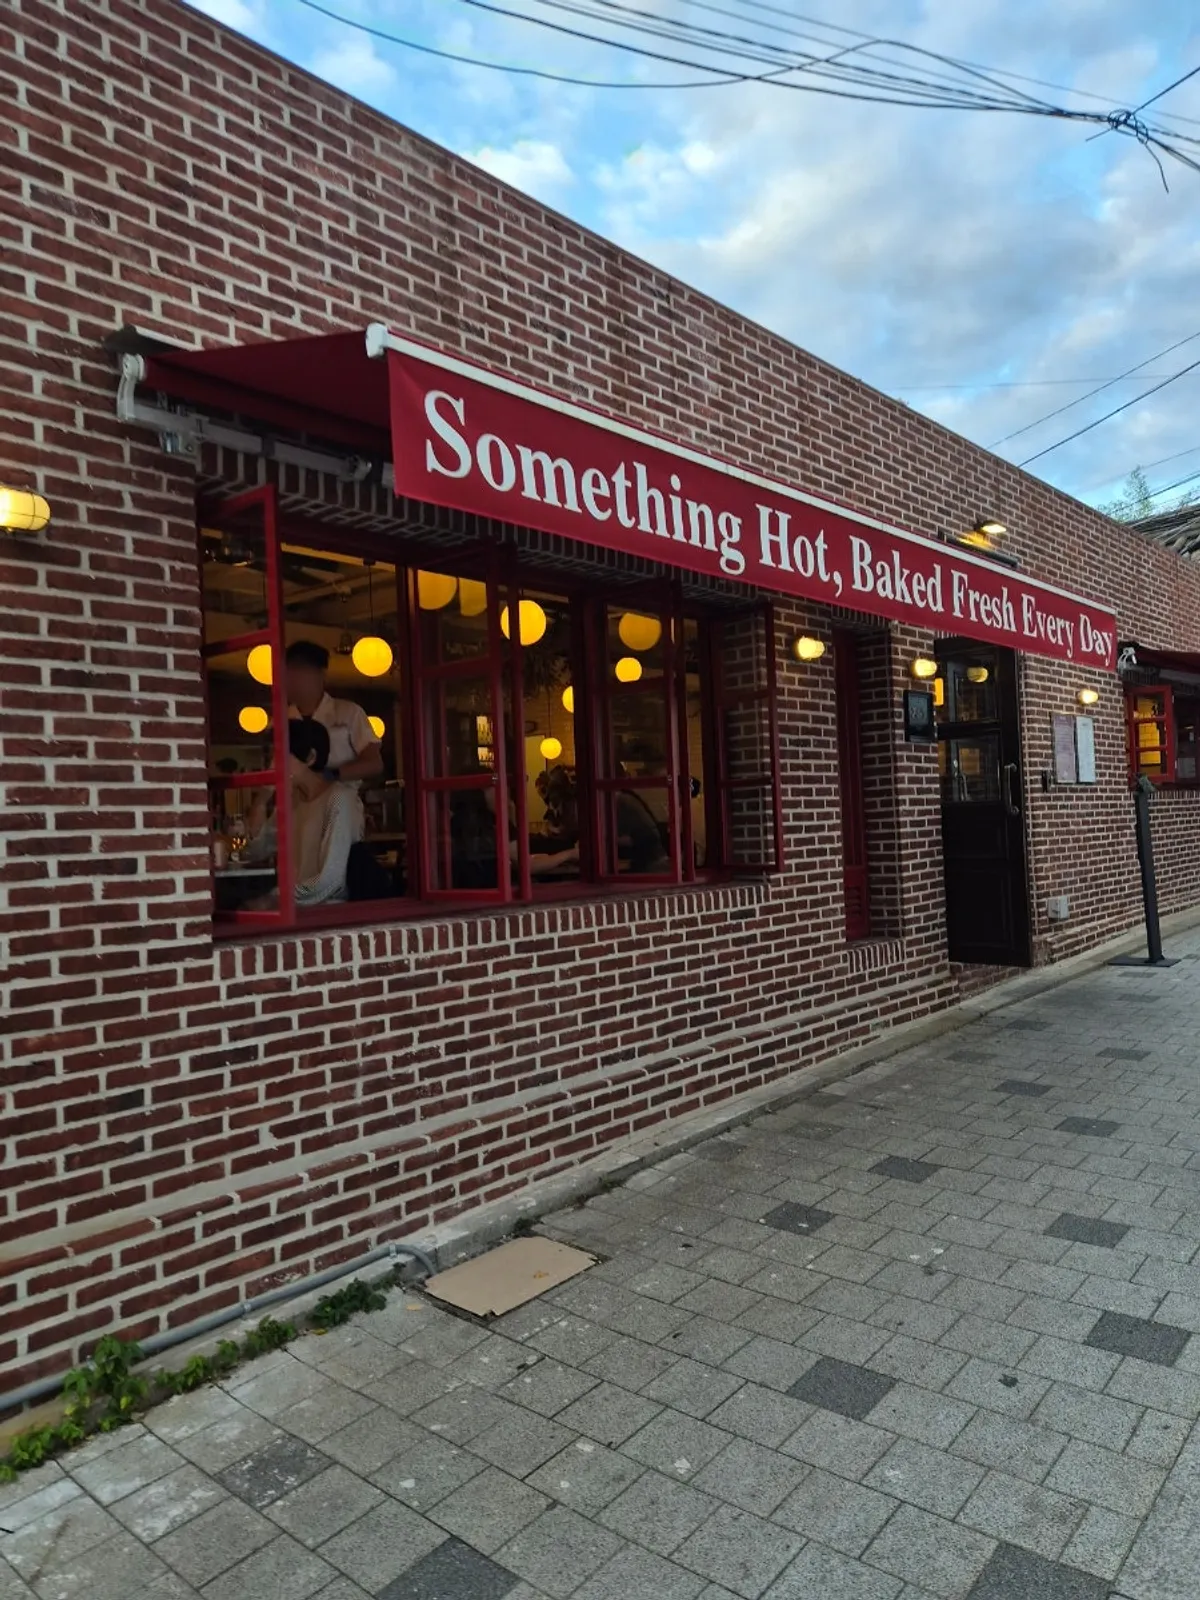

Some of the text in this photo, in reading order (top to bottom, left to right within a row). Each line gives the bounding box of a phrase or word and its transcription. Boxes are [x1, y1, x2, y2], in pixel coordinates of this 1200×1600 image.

[424, 390, 1113, 667] Something Hot, Baked Fresh Every Day
